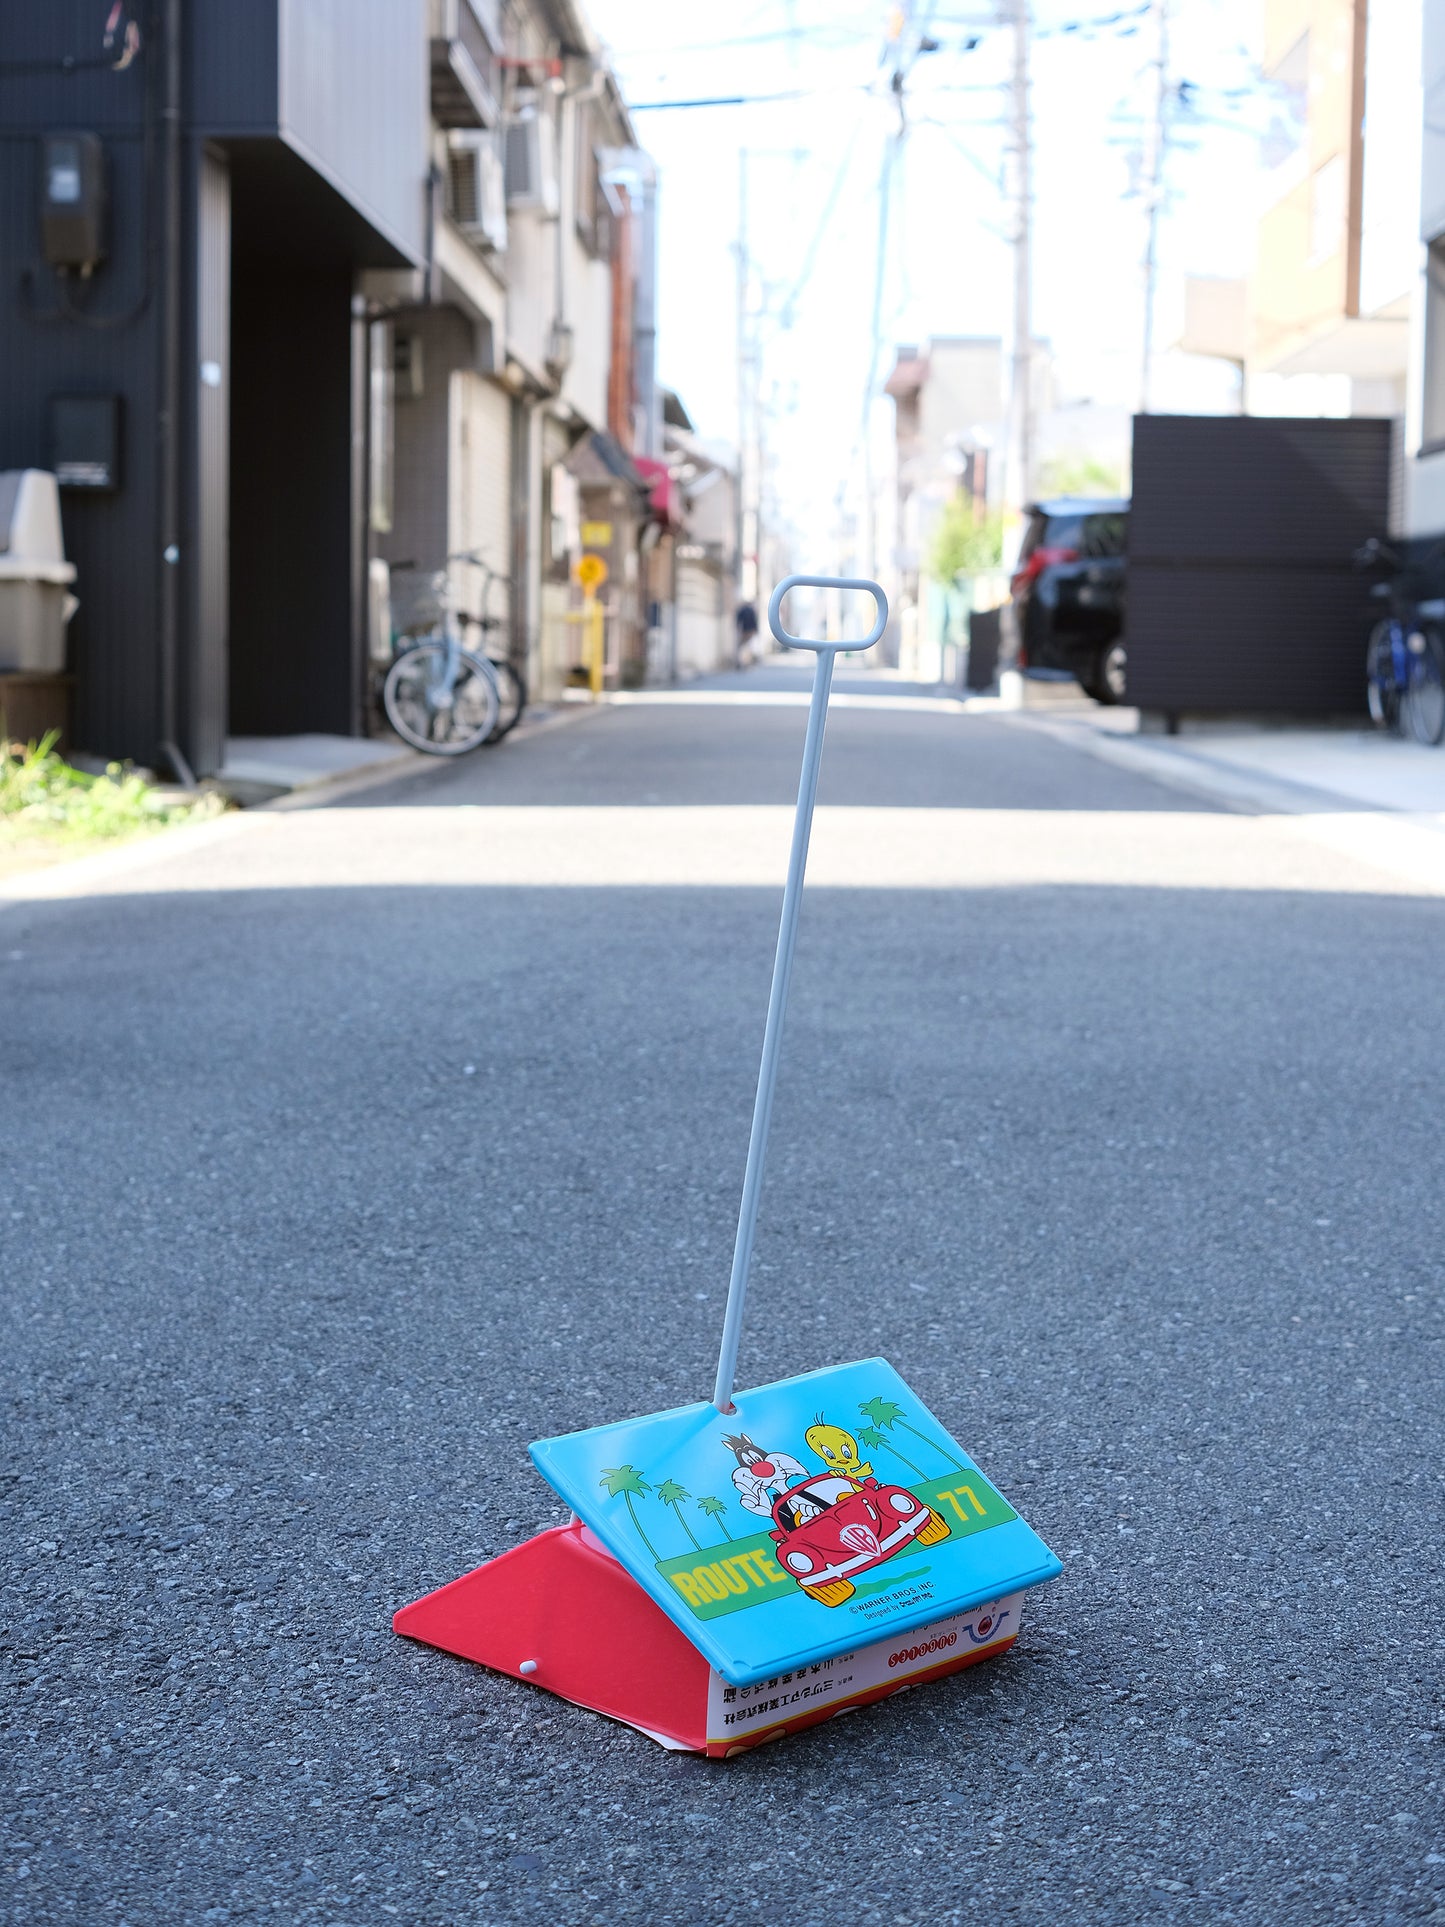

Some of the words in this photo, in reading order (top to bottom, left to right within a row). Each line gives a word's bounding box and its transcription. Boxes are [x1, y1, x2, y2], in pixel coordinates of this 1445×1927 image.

[670, 1548, 788, 1607] ROUTE
[936, 1485, 987, 1522] 77
[917, 1581, 937, 1592] INC.
[864, 1606, 892, 1621] Designed
[891, 1603, 900, 1612] by
[888, 1632, 957, 1668] BUBBLES
